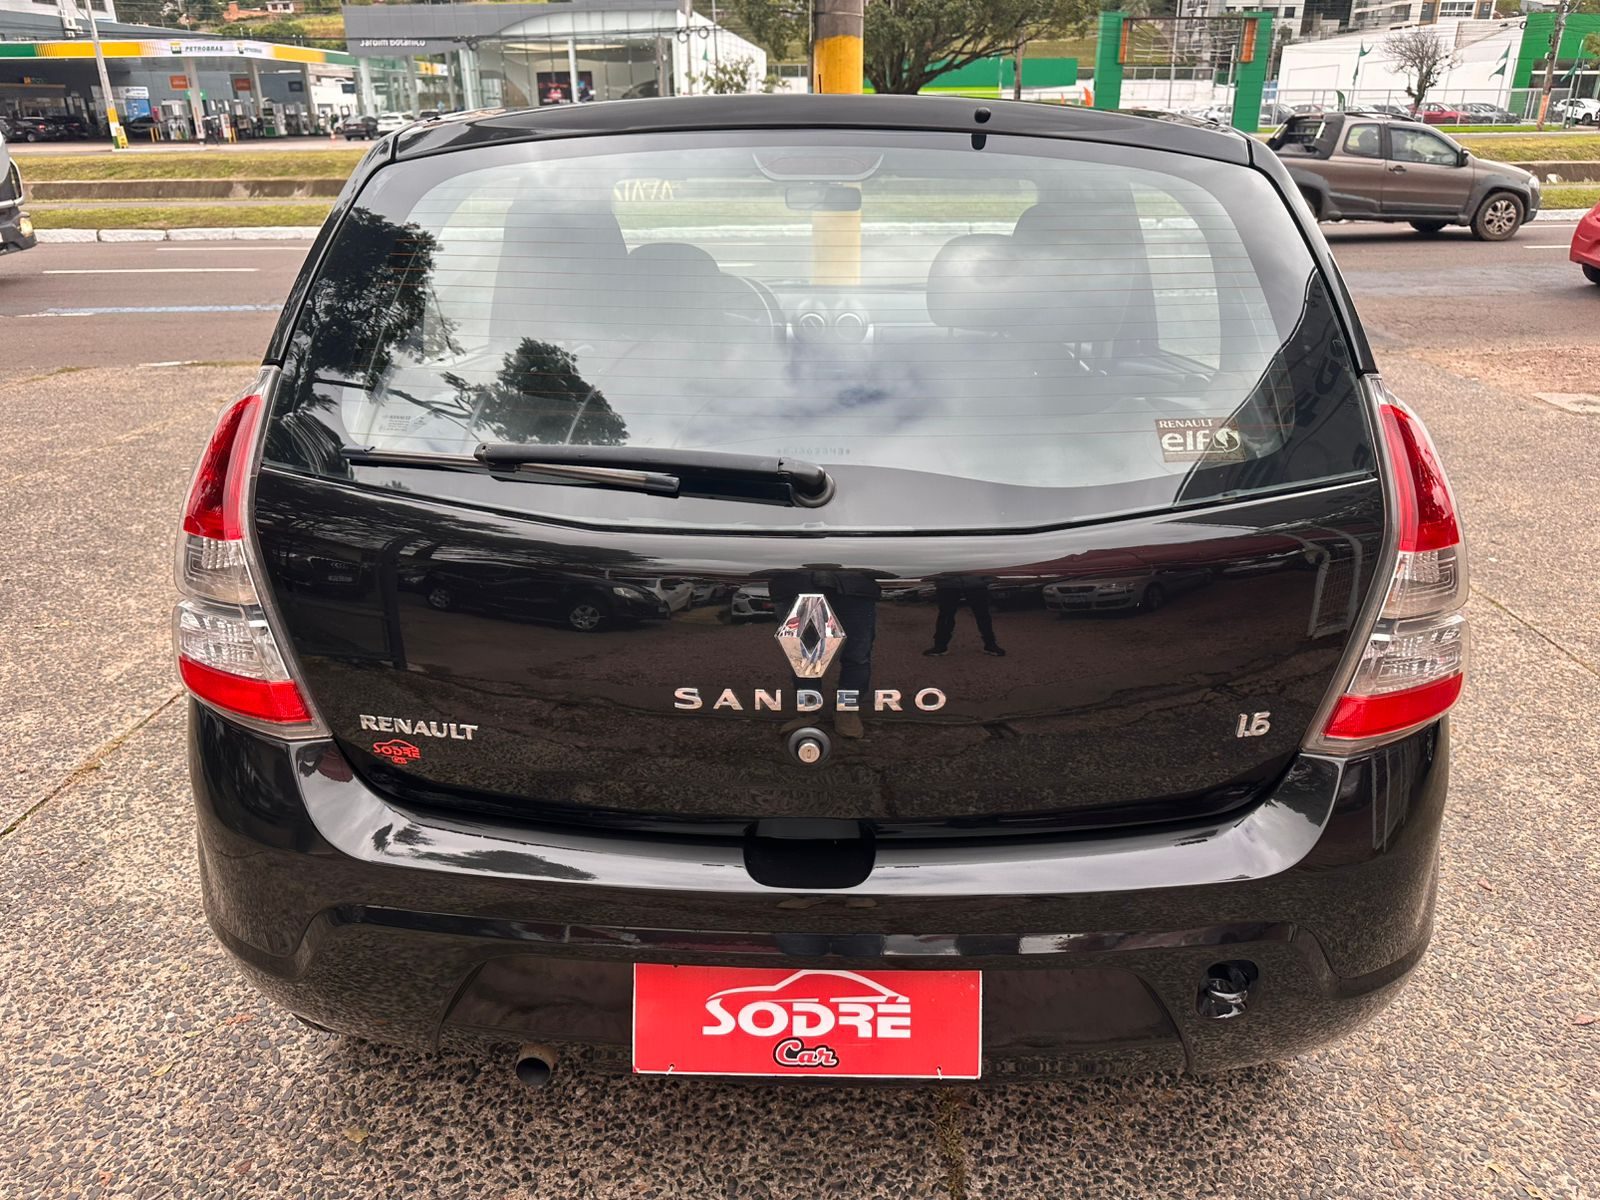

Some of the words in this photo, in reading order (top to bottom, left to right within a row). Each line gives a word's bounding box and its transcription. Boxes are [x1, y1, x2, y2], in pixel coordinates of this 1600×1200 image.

[1159, 418, 1214, 429] RENAULT
[1161, 429, 1210, 451] elf
[674, 687, 947, 712] SANDERO
[360, 714, 479, 740] RENAULT
[1236, 711, 1271, 738] 1.6
[774, 1037, 840, 1068] Car
